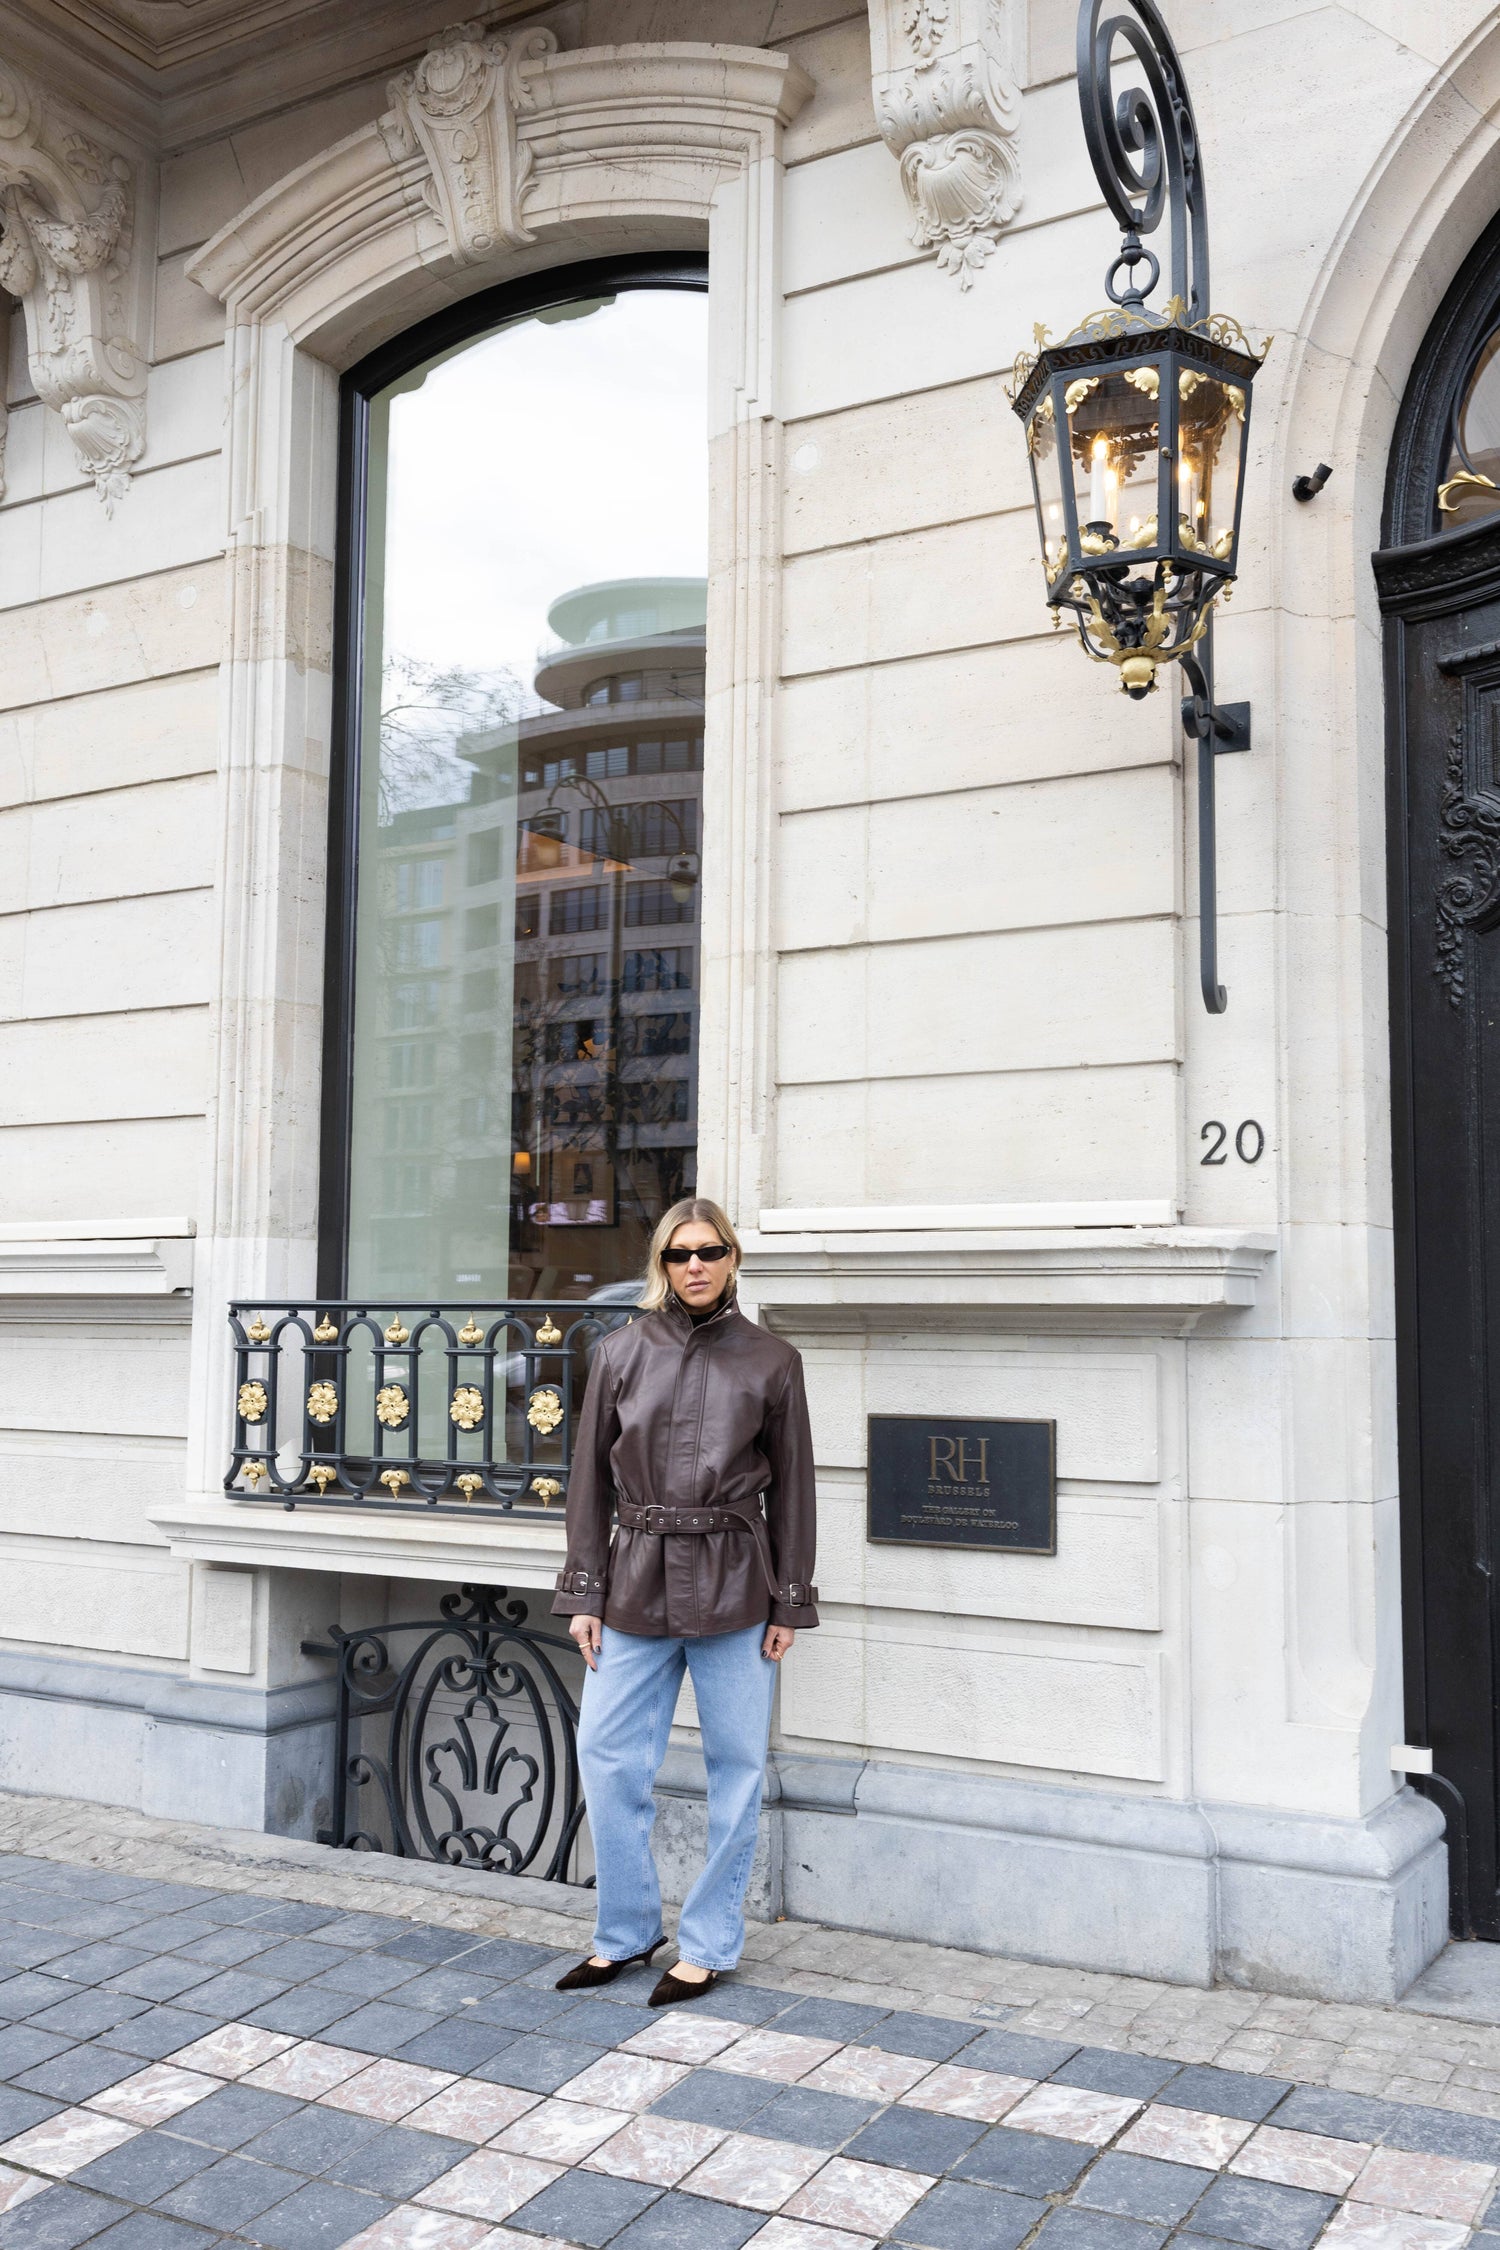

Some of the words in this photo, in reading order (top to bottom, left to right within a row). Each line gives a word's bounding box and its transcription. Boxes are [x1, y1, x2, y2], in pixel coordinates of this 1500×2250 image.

[1200, 1119, 1265, 1165] 20
[928, 1436, 990, 1484] RH
[927, 1485, 991, 1497] BRUSSELS
